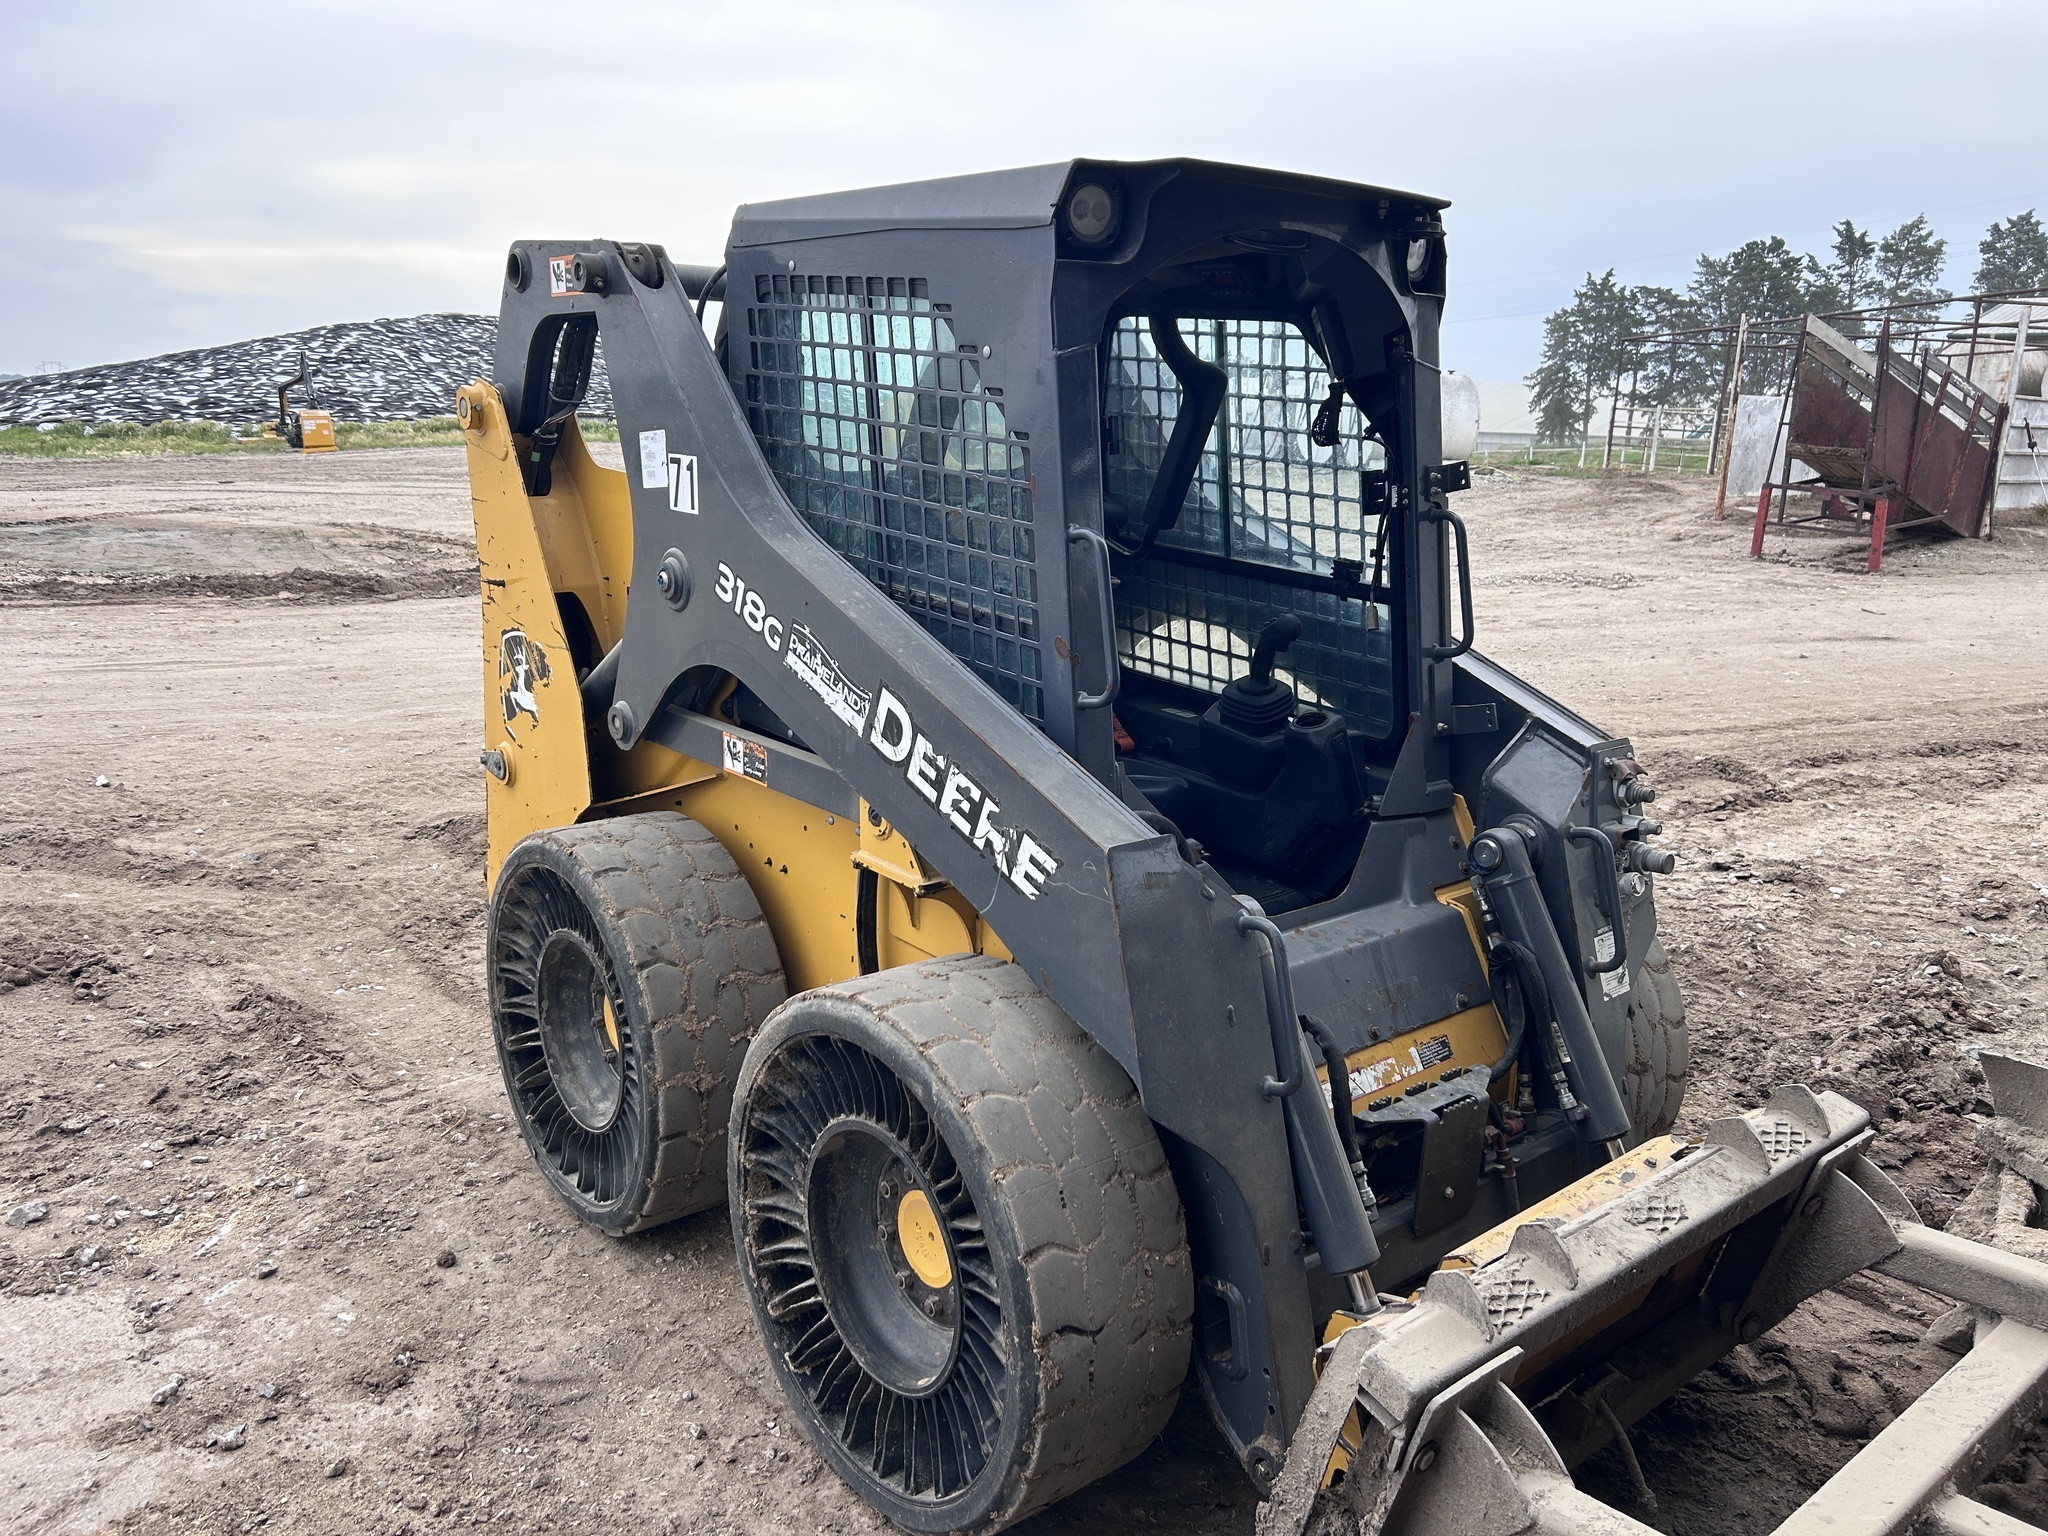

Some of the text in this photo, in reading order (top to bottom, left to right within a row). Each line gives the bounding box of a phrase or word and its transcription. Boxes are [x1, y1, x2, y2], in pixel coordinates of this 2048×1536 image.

[670, 457, 695, 510] 71
[715, 562, 784, 652] 318G
[870, 687, 1058, 900] DEERE
